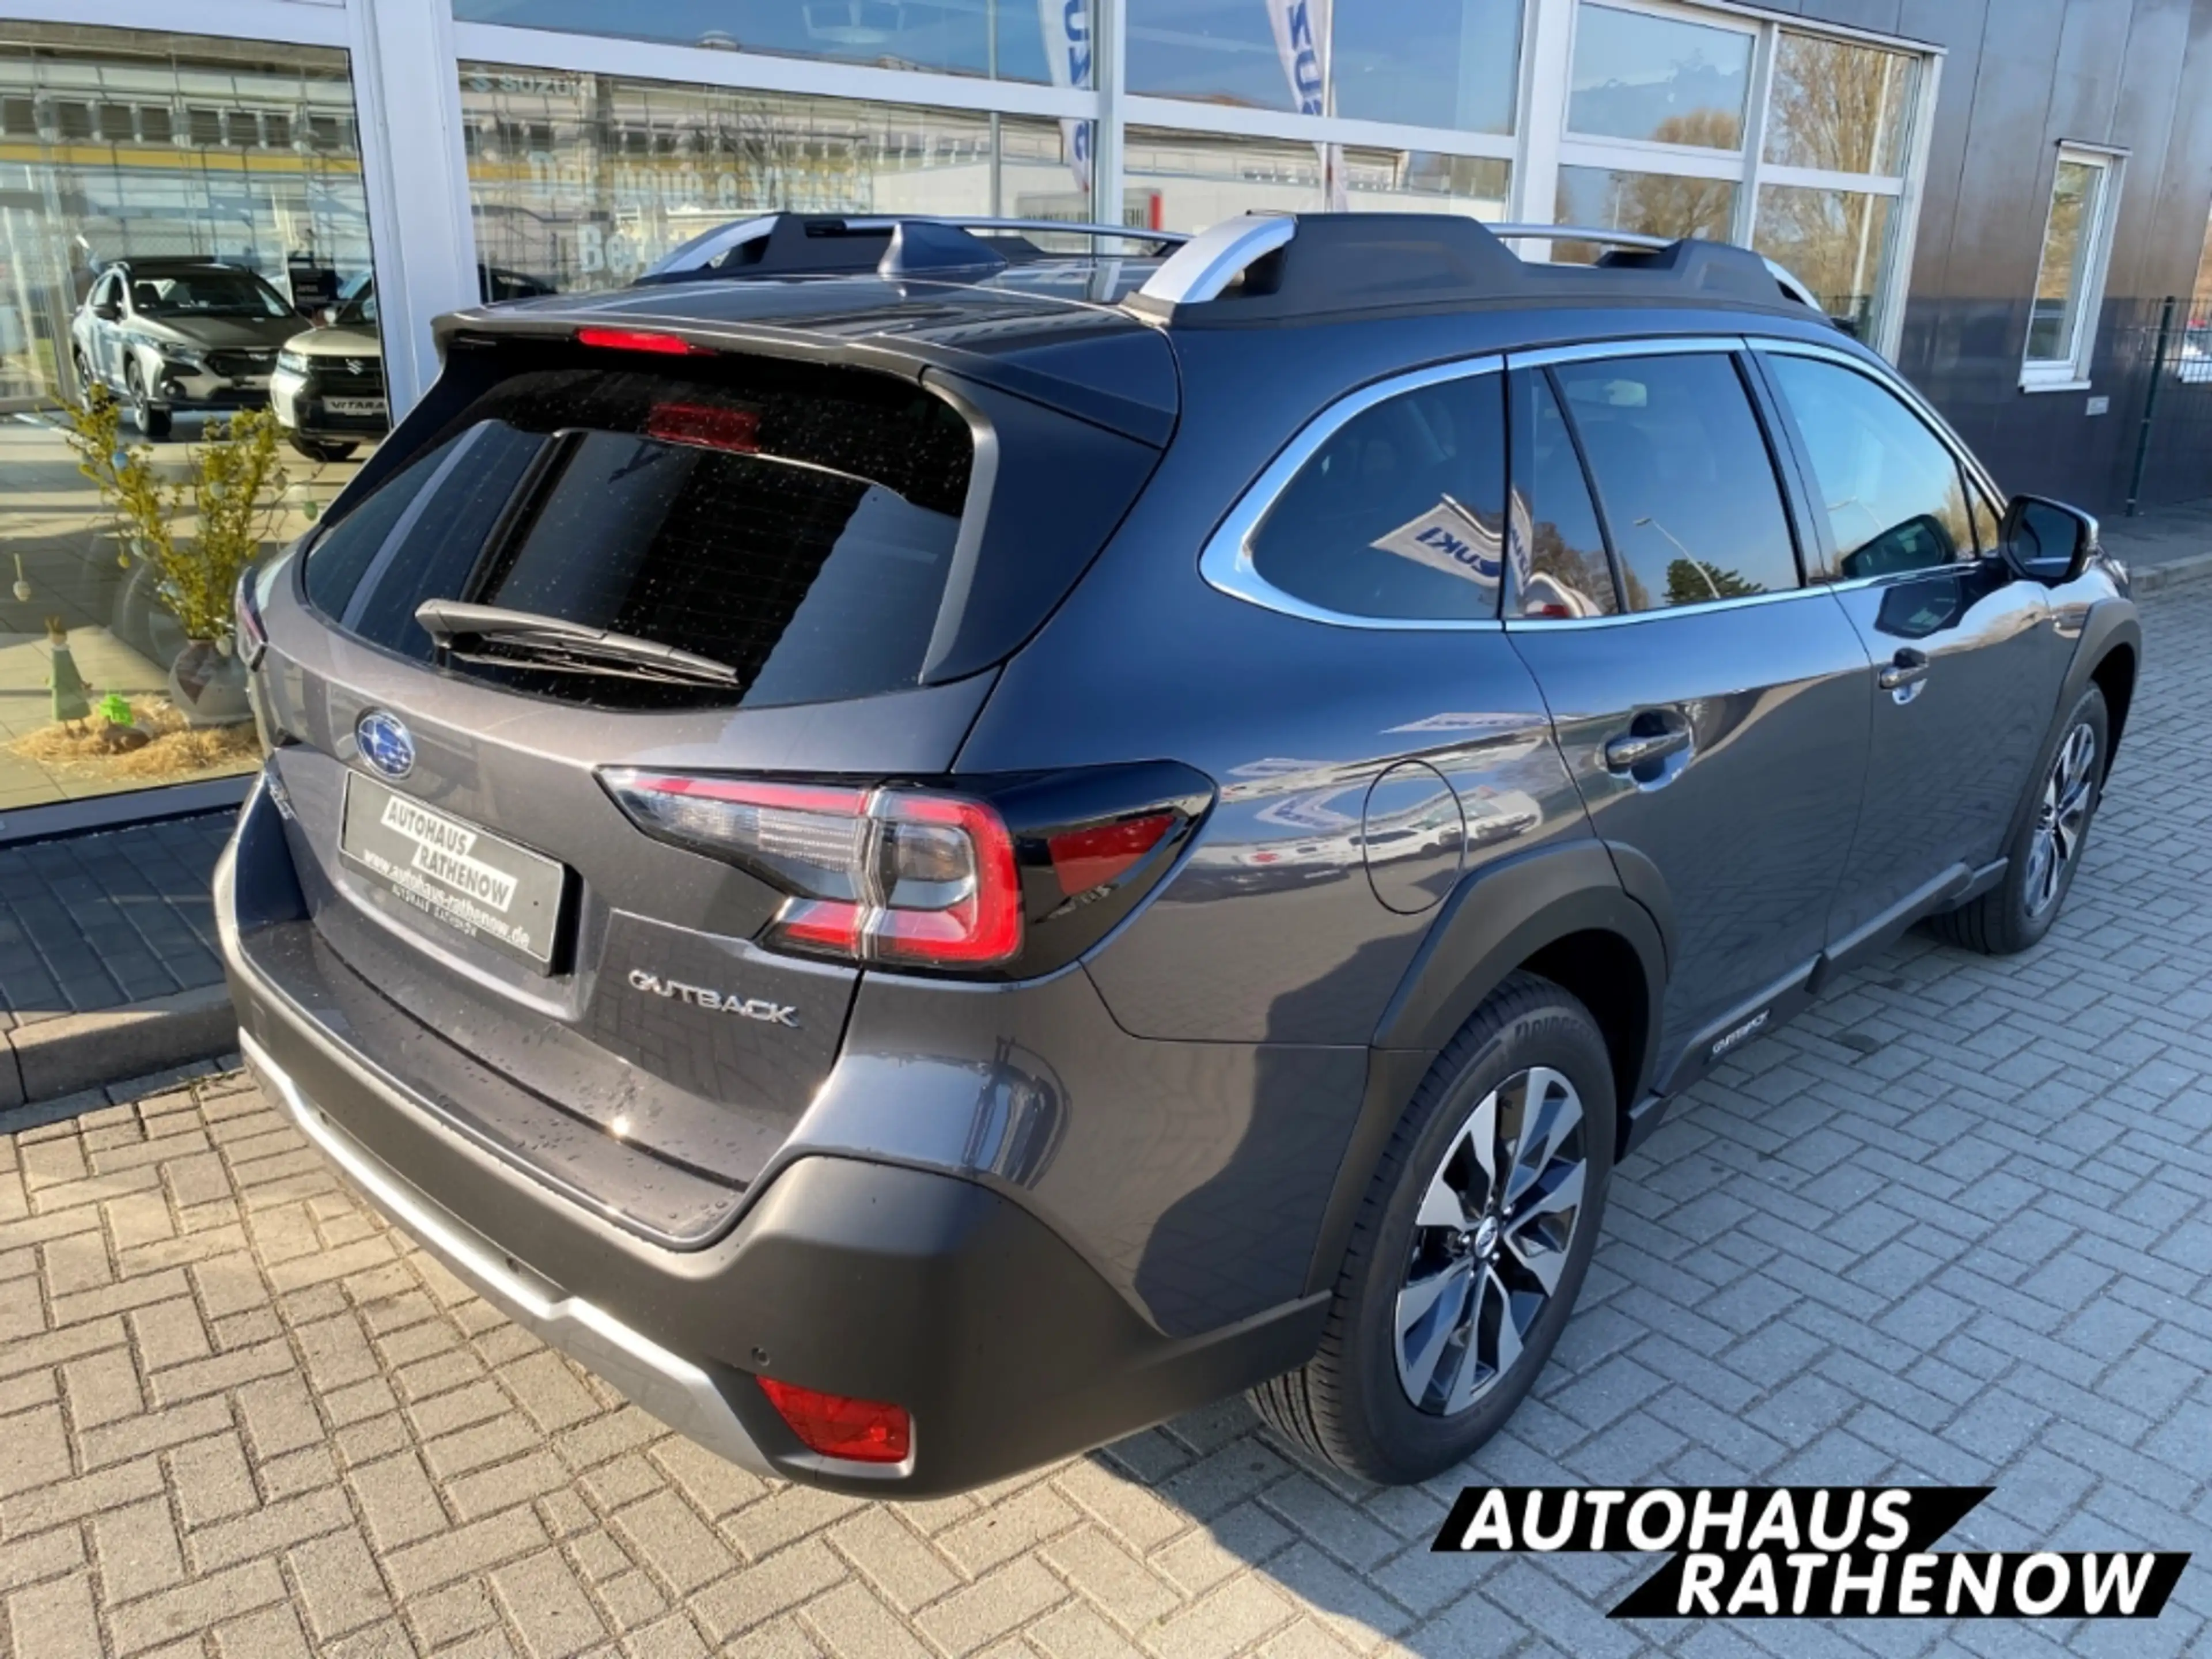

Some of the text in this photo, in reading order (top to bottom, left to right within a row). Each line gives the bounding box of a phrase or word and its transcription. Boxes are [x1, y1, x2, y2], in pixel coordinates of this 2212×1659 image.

[387, 801, 468, 855] AUTOHAUS
[363, 849, 530, 948] www.autohaus-rathenow.de
[420, 846, 512, 907] RATHENOW
[628, 969, 800, 1028] OUTBACK
